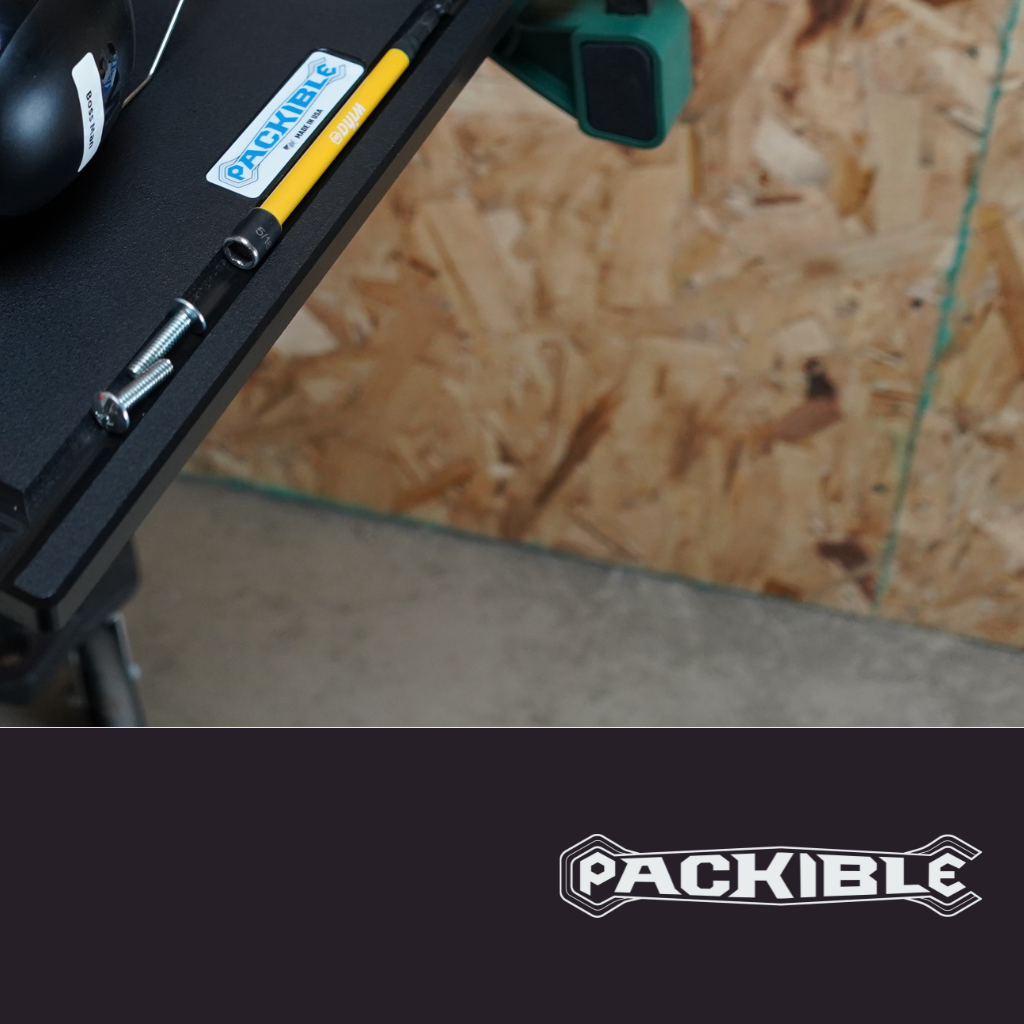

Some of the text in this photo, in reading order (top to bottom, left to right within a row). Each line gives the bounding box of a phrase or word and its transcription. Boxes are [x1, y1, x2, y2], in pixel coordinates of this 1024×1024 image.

[85, 90, 96, 150] Boss Man
[227, 63, 337, 181] PACKIBLE
[294, 124, 310, 139] MADE
[312, 108, 324, 120] USA
